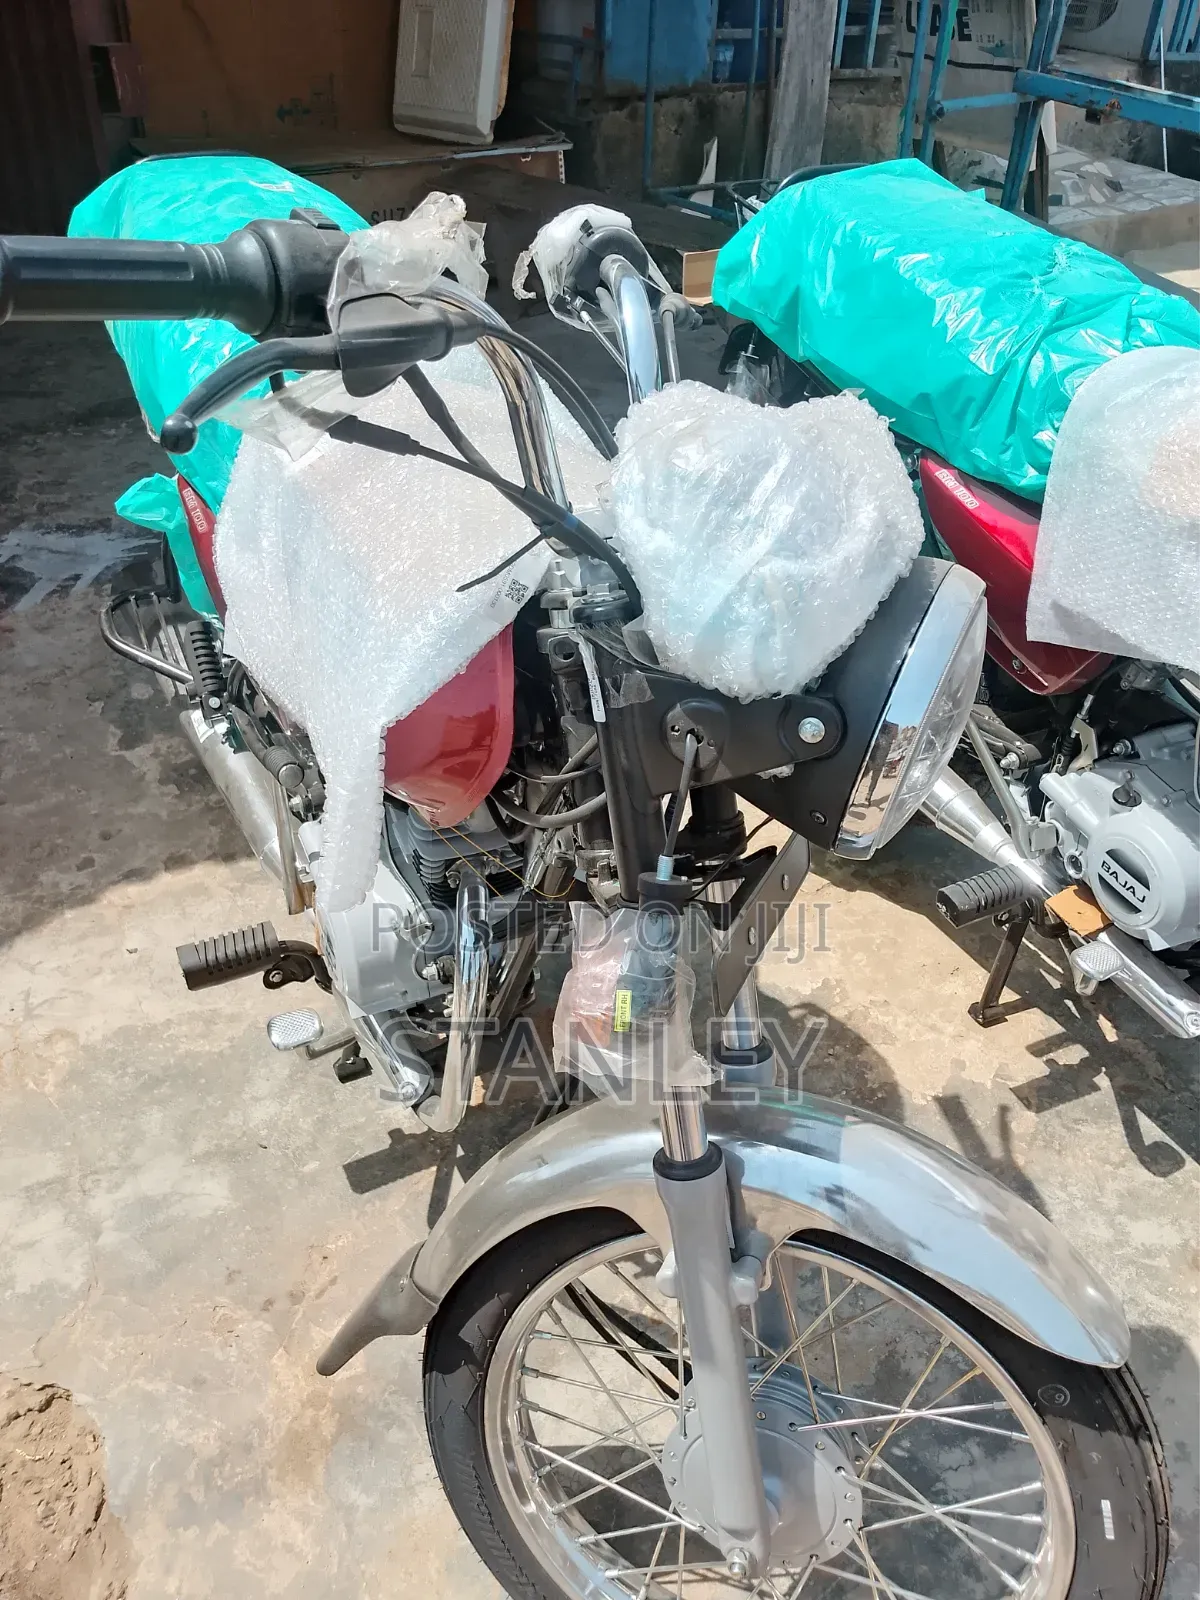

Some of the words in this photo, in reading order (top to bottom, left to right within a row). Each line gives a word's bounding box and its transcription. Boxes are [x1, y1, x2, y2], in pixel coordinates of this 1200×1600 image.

[371, 207, 416, 223] SUZ
[954, 486, 979, 510] 100
[191, 508, 208, 533] 100
[1101, 860, 1146, 903] BAJAJ
[621, 994, 628, 1005] RH
